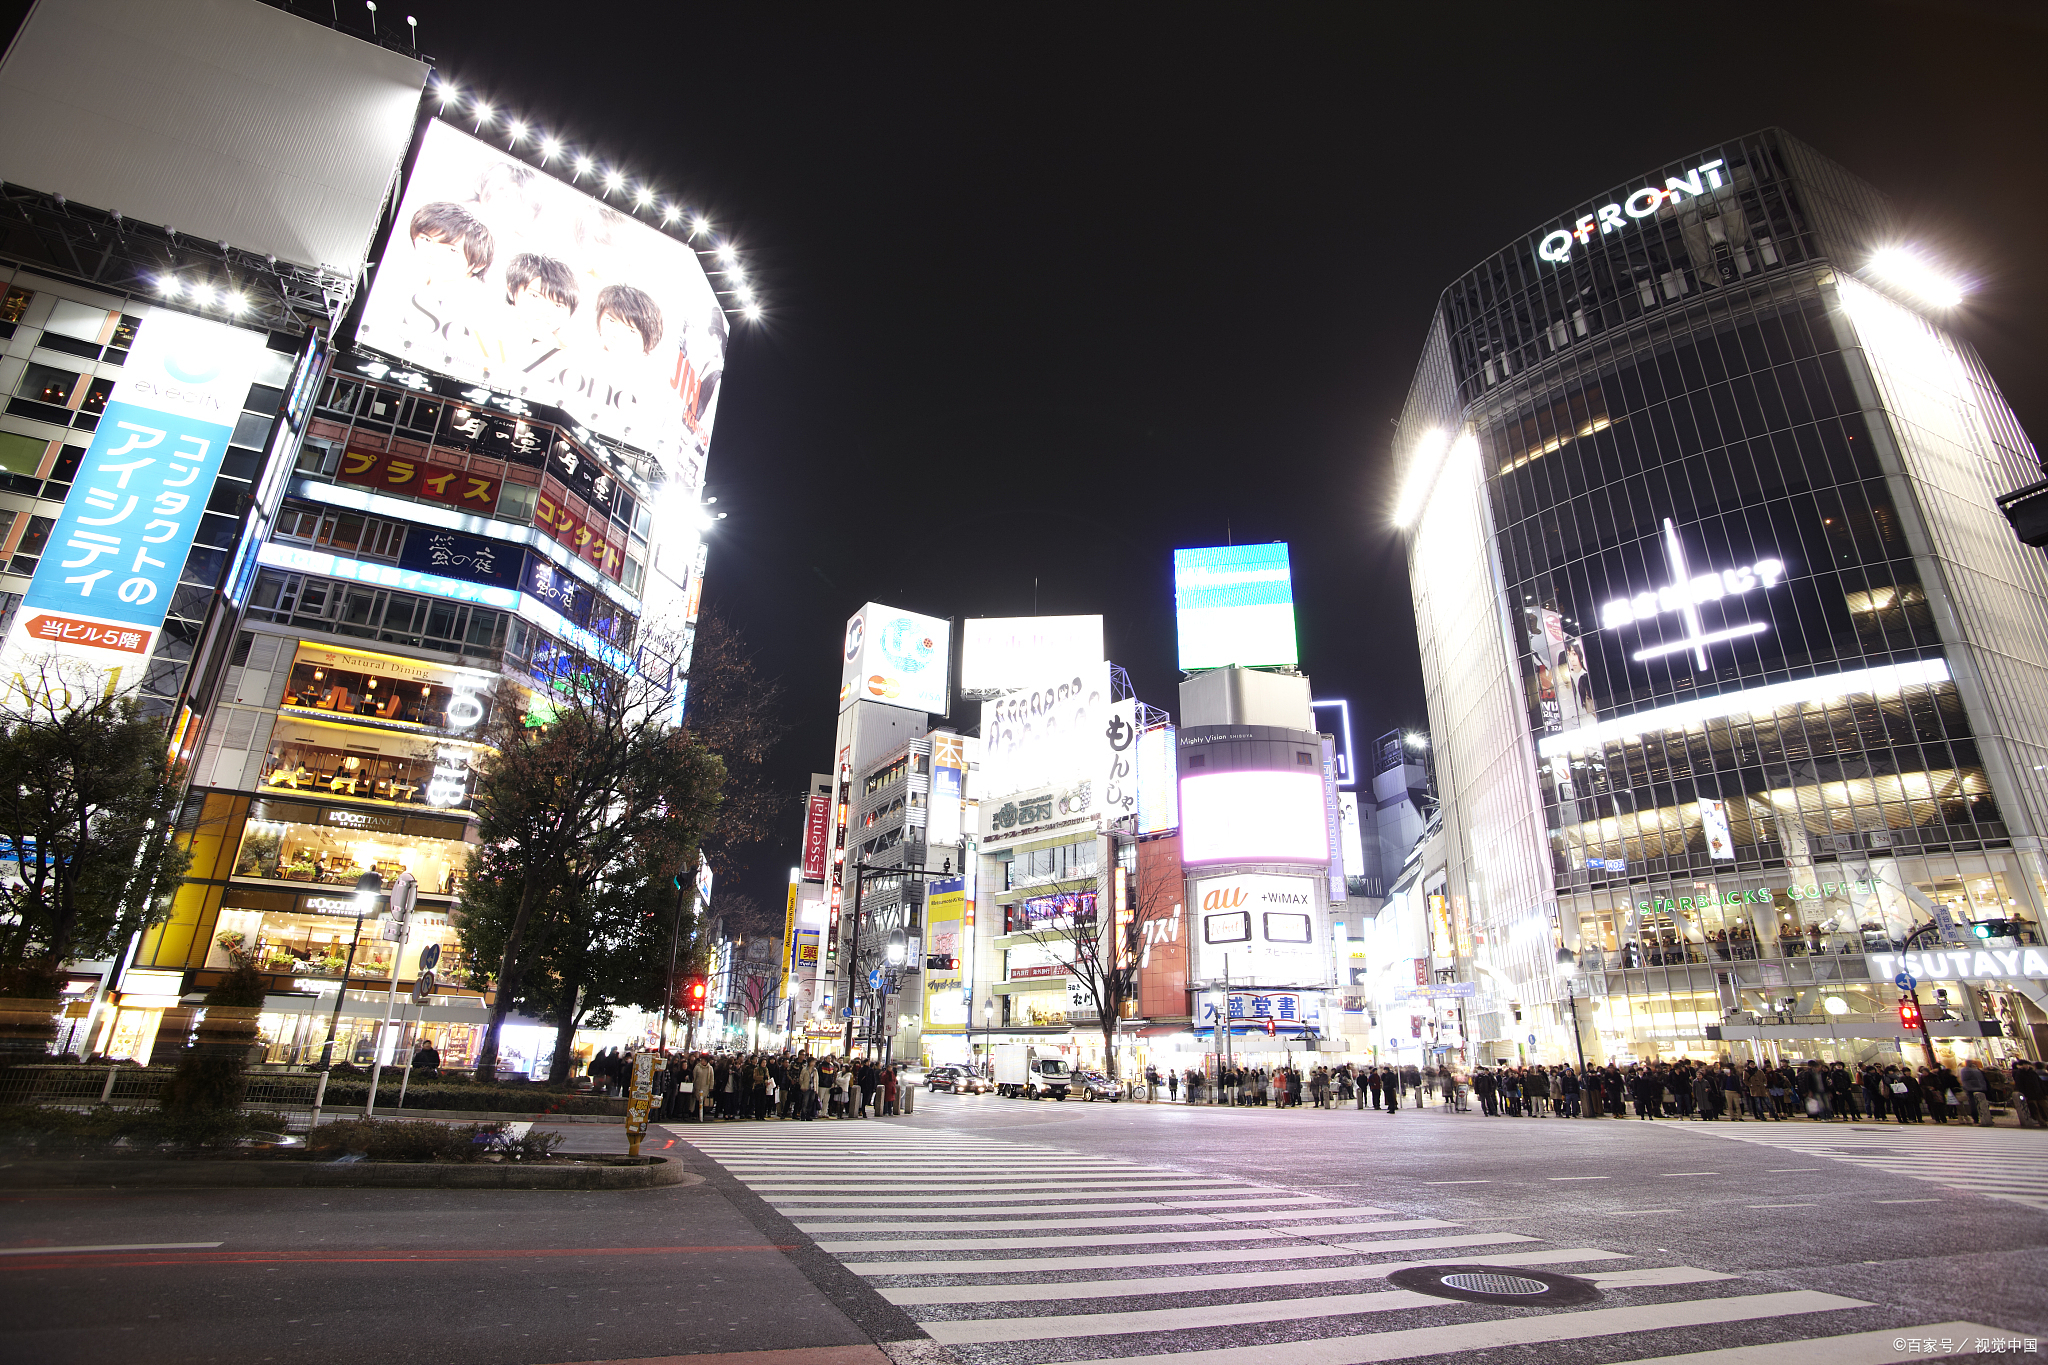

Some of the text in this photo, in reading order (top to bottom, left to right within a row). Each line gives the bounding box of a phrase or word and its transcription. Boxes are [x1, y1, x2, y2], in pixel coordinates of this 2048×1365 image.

[670, 350, 701, 417] JIN
[343, 450, 492, 504] プライス
[61, 420, 167, 597] アイシティ
[118, 434, 210, 605] コンタクトの
[536, 495, 621, 570] コンタクト
[40, 619, 142, 650] 当ビル5階
[342, 655, 430, 679] Natural Dining
[1180, 737, 1203, 746] Mighty
[1205, 734, 1227, 744] Vision
[1105, 714, 1134, 812] もんじゃ
[329, 811, 393, 826] L'OCCITANE
[1019, 801, 1052, 826] 西村
[805, 798, 825, 875] Essential
[1203, 887, 1248, 911] au
[1638, 887, 1774, 916] STARBUCKS
[1141, 903, 1181, 969] クスリ
[803, 946, 817, 959] 薬
[1872, 949, 2048, 979] TSUTAYA
[1204, 996, 1320, 1019] 大盛堂書店
